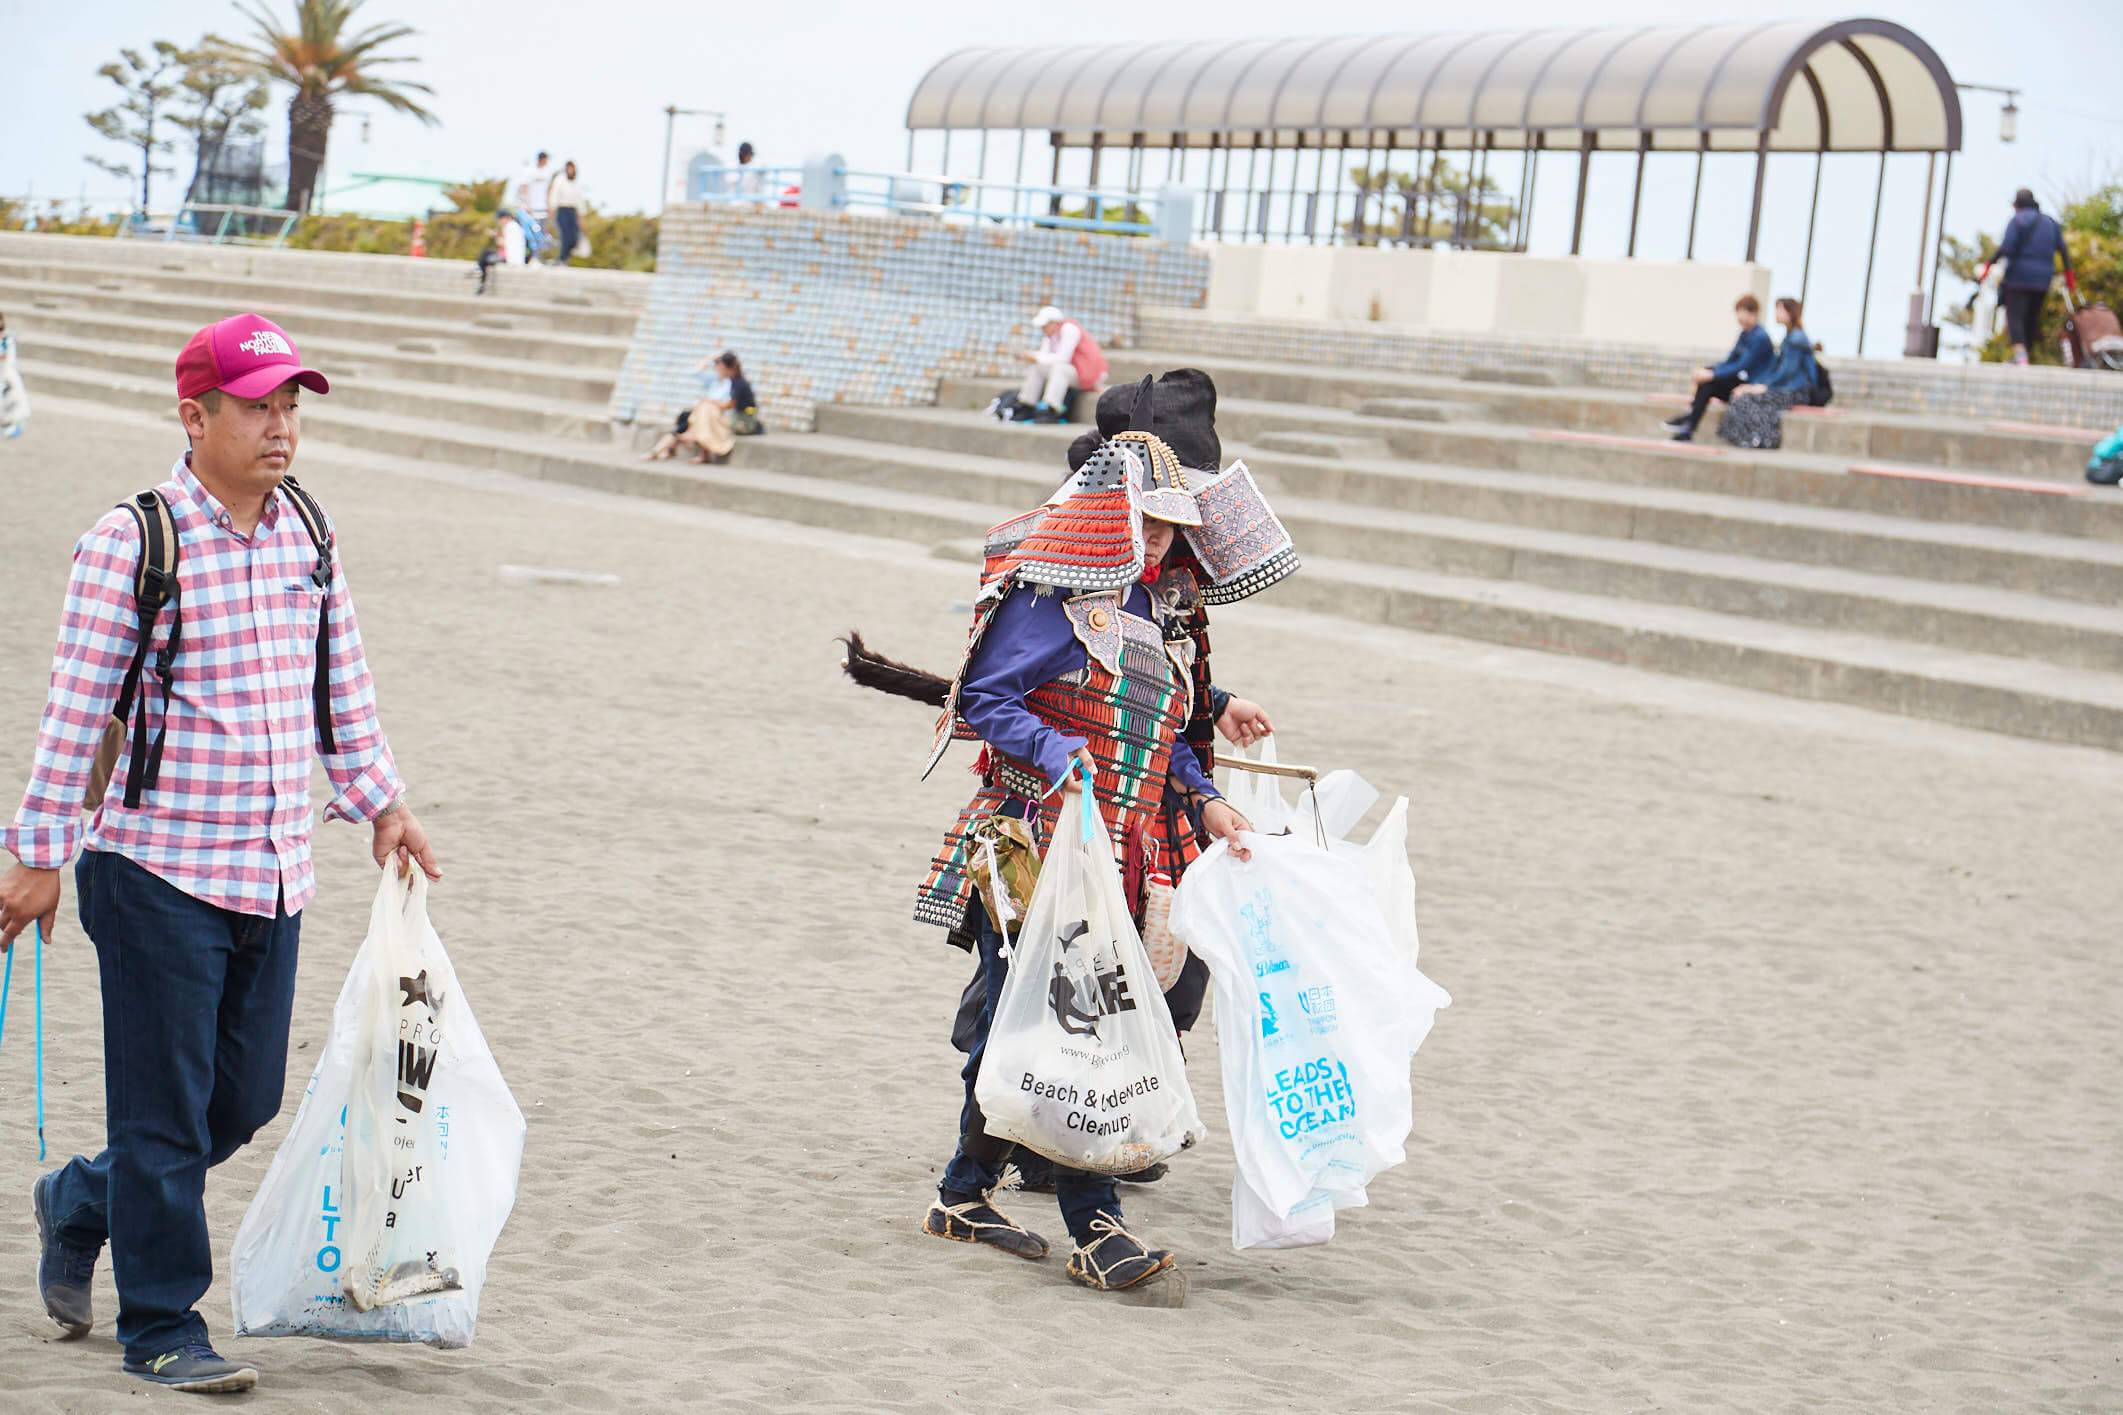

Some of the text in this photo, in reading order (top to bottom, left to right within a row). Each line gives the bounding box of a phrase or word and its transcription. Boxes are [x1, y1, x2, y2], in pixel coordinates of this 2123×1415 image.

[239, 337, 277, 352] NORTH
[251, 331, 274, 342] THE
[253, 345, 279, 356] FACE
[1020, 1071, 1079, 1105] Beach
[1084, 1089, 1098, 1109] &
[1266, 1057, 1333, 1098] LEADS
[1269, 1078, 1345, 1119] TO THE
